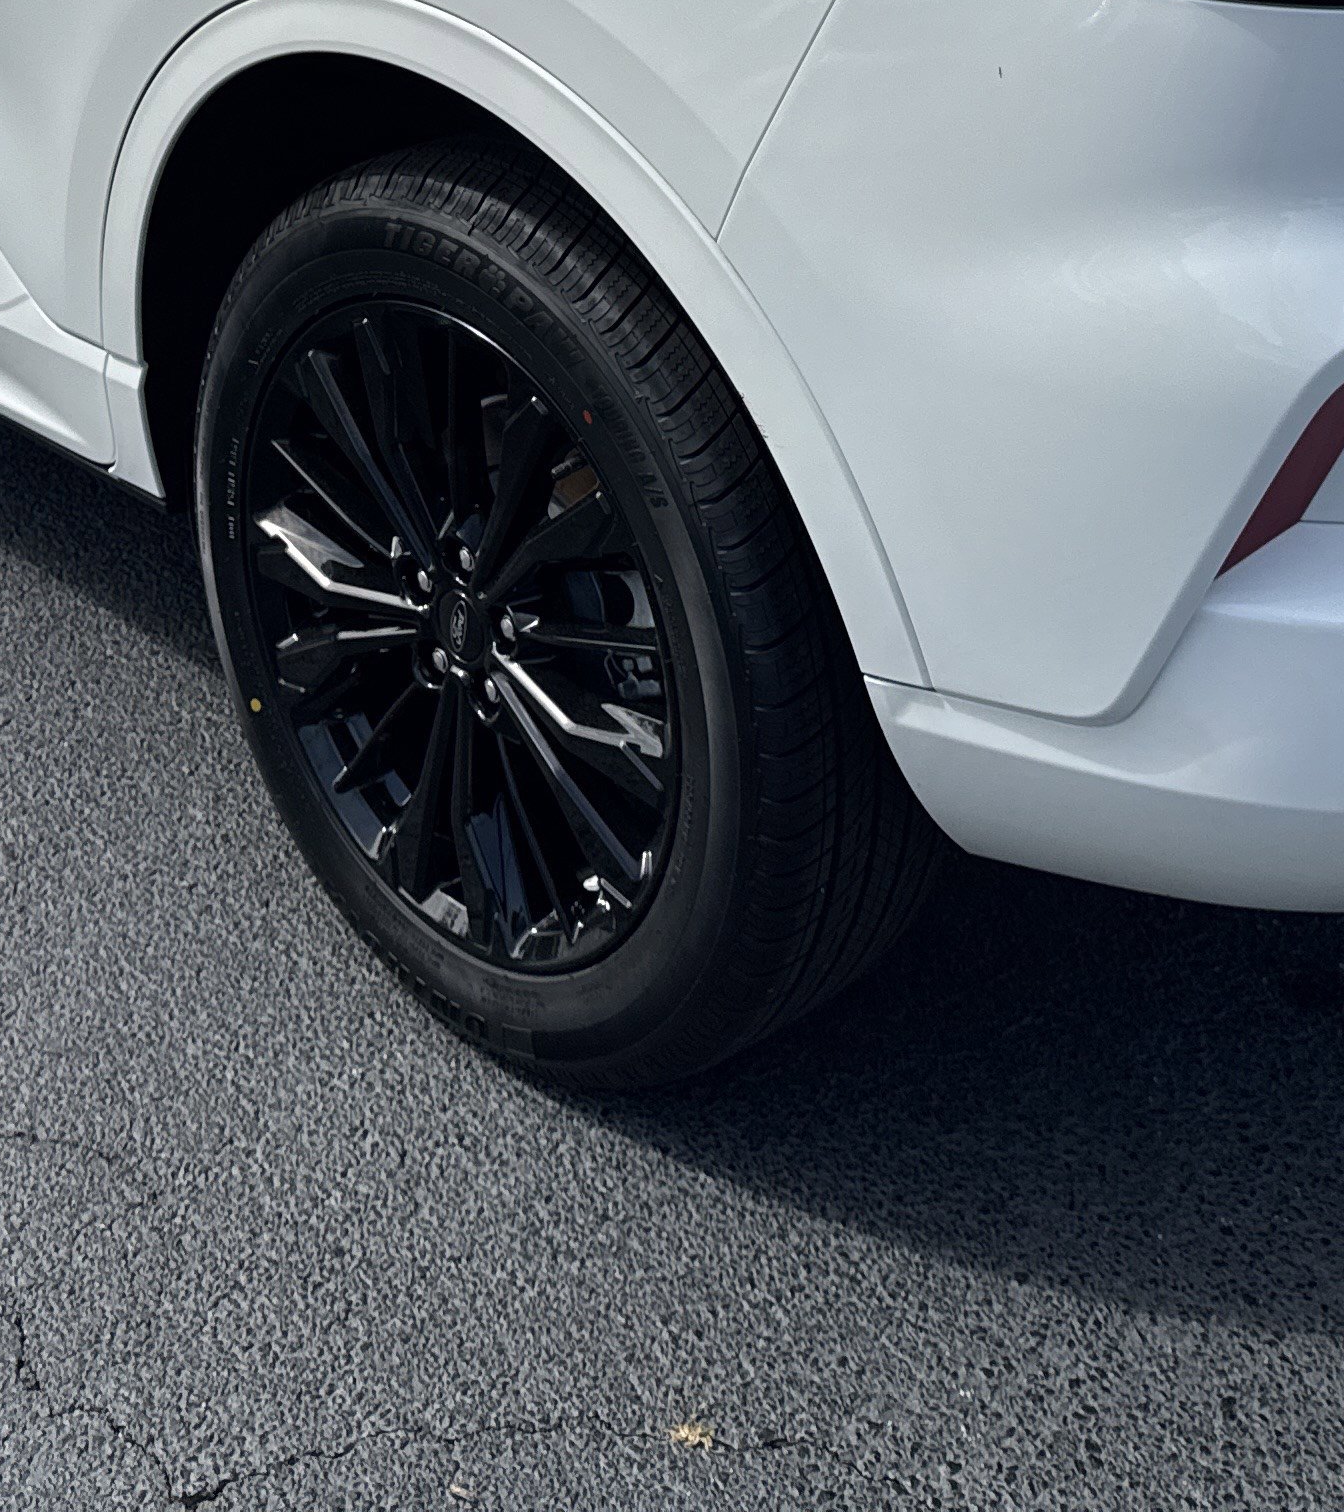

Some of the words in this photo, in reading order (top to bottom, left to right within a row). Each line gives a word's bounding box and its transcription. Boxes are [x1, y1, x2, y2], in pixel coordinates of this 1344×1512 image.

[384, 222, 481, 283] TIGER
[507, 287, 586, 368] PAW
[635, 471, 669, 509] A/S
